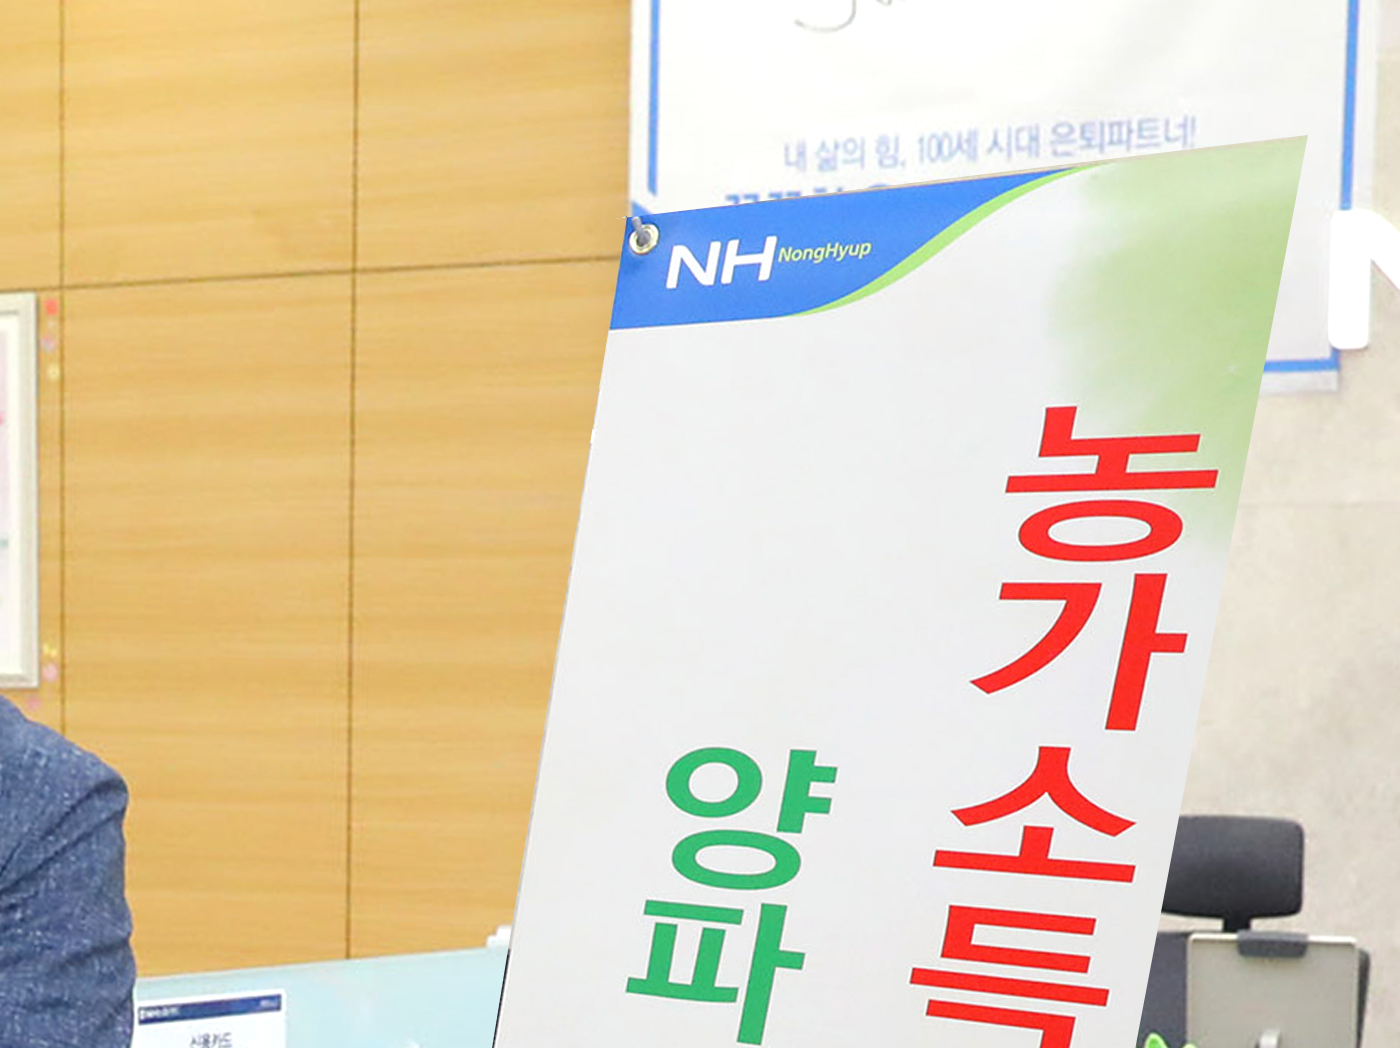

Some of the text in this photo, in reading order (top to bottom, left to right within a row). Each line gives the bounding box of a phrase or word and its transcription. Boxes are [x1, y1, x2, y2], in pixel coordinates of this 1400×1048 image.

[784, 137, 807, 173] 내
[816, 135, 866, 172] 삶의
[919, 127, 978, 163] 100세
[986, 123, 1040, 160] 시대
[666, 237, 872, 289] NH NongHyup
[627, 748, 836, 1044] 양파
